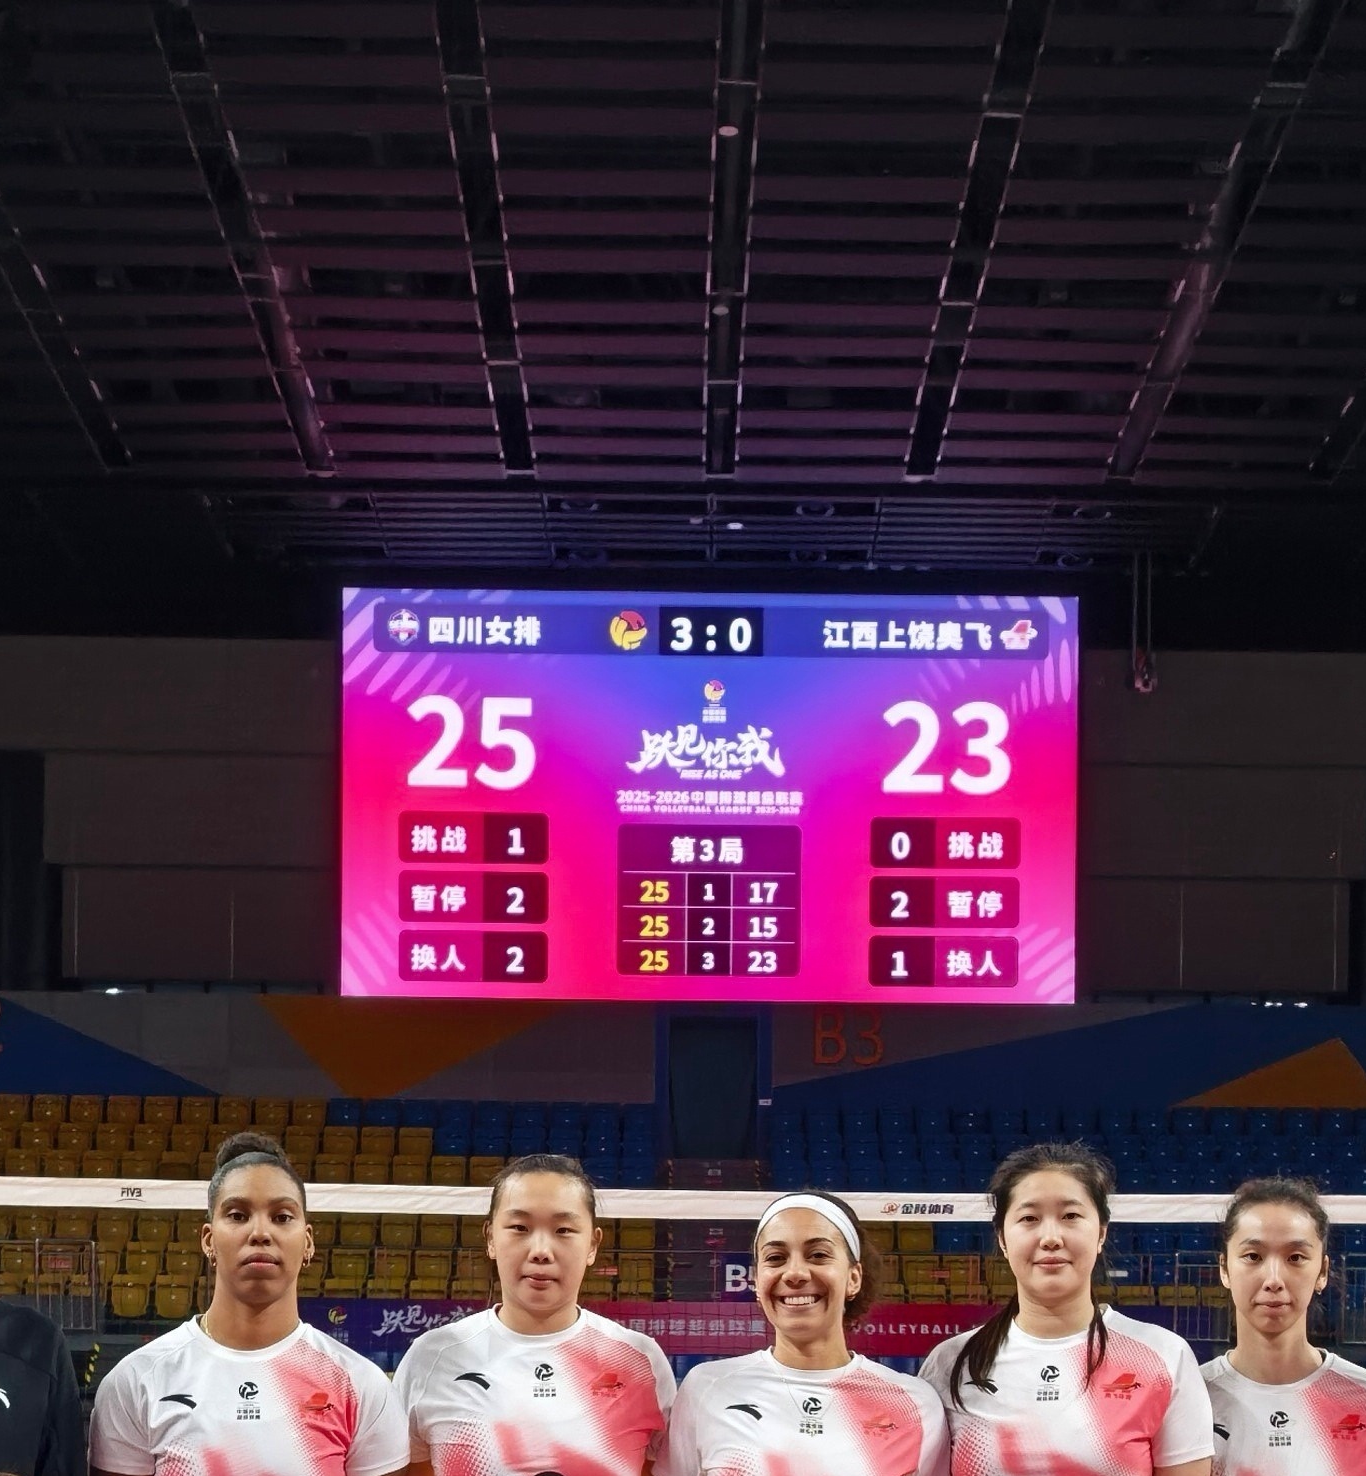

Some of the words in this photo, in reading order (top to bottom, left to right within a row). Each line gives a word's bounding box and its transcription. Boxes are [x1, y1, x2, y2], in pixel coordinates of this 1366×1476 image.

[429, 616, 541, 646] 四川女排
[670, 617, 753, 652] 3:0
[823, 620, 992, 650] 江西上饶奥飞
[407, 694, 536, 790] 25
[882, 700, 1012, 794] 23
[411, 825, 467, 854] 挑战
[507, 827, 525, 856] 1
[670, 836, 744, 864] 第3局
[890, 832, 911, 860] 0
[947, 831, 1003, 860] 挑战
[411, 885, 467, 912] 暂停
[506, 887, 525, 915] 2
[639, 881, 670, 903] 25
[703, 884, 715, 901] 1
[749, 882, 778, 904] 17
[890, 891, 910, 918] 2
[947, 891, 1003, 918] 暂停
[639, 915, 669, 937] 25
[701, 918, 716, 935] 2
[749, 916, 777, 938] 15
[411, 945, 466, 972] 换人
[506, 946, 525, 973] 2
[639, 950, 669, 972] 25
[702, 952, 715, 970] 3
[748, 951, 777, 973] 23
[890, 951, 909, 977] 1
[947, 950, 1002, 977] 换人
[812, 1008, 884, 1066] B3
[901, 1203, 954, 1215] 金陵体育
